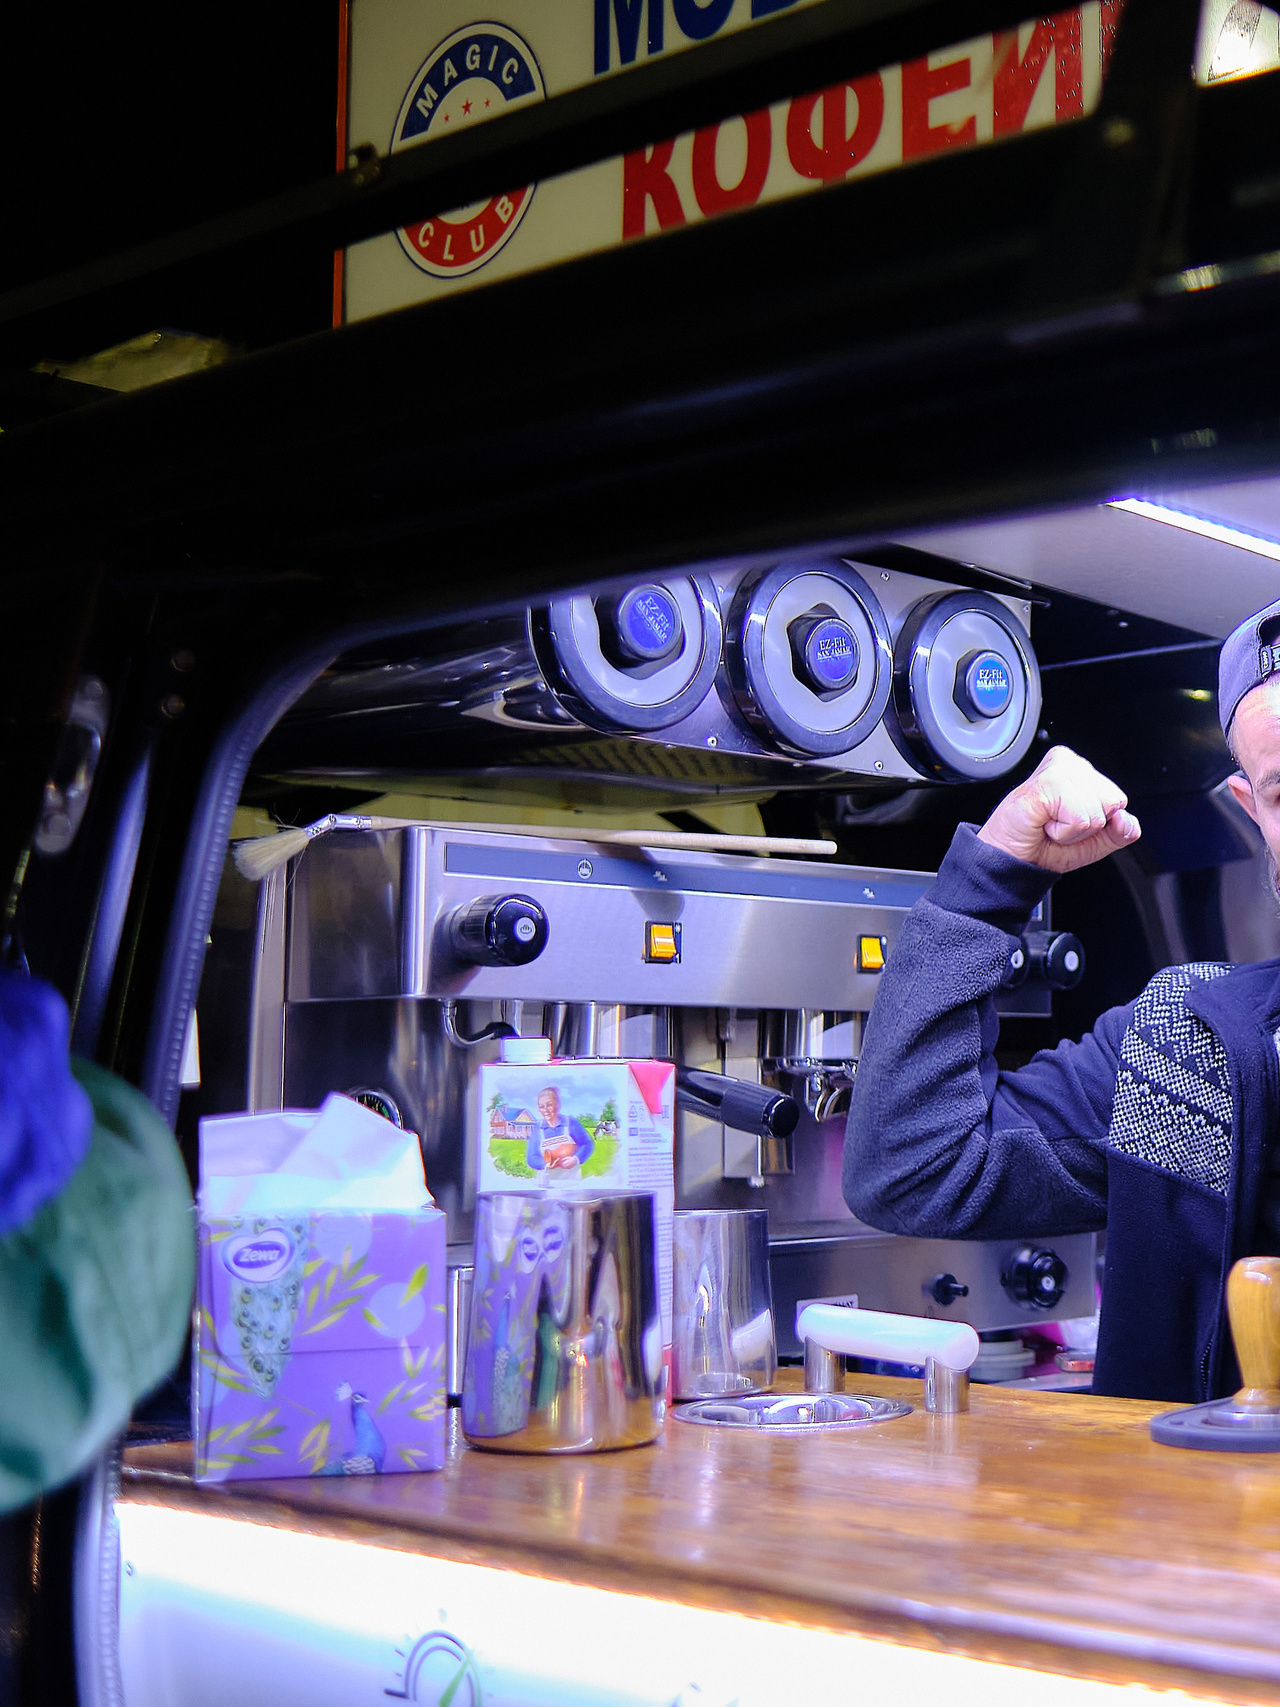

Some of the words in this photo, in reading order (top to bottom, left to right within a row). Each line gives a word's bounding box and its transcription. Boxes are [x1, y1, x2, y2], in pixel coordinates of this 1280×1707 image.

[415, 43, 519, 119] MAGIC
[418, 194, 515, 261] CLUB
[645, 596, 671, 631] EZ-Fit
[819, 636, 847, 650] EZ-Fit
[979, 668, 1004, 679] EZ-Fit
[239, 1248, 280, 1262] Zewa
